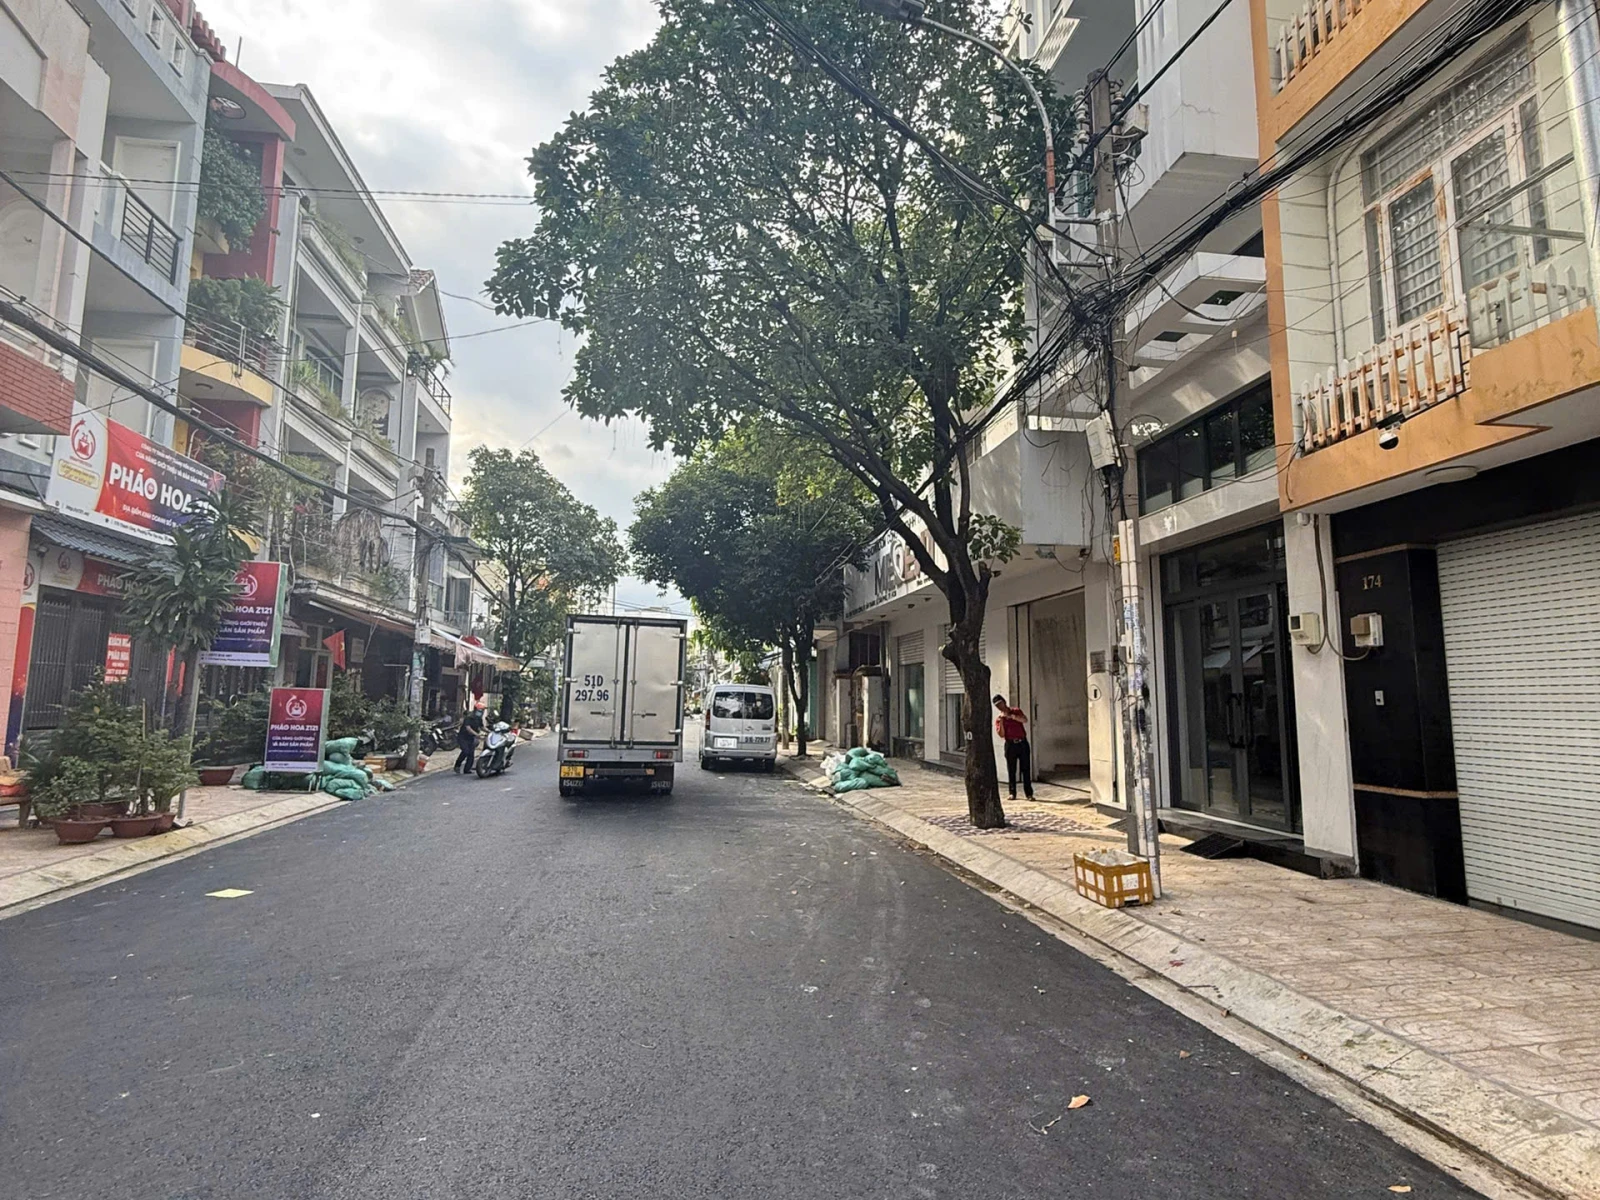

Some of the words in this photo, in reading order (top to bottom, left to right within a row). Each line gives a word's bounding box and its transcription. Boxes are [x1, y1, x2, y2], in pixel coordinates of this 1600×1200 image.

[109, 461, 158, 500] PHÁO
[160, 483, 193, 514] HOA
[97, 573, 122, 590] PHÁO
[1362, 574, 1382, 590] 174
[235, 606, 255, 614] HOA
[584, 674, 603, 687] 51D
[575, 690, 609, 702] 297.96
